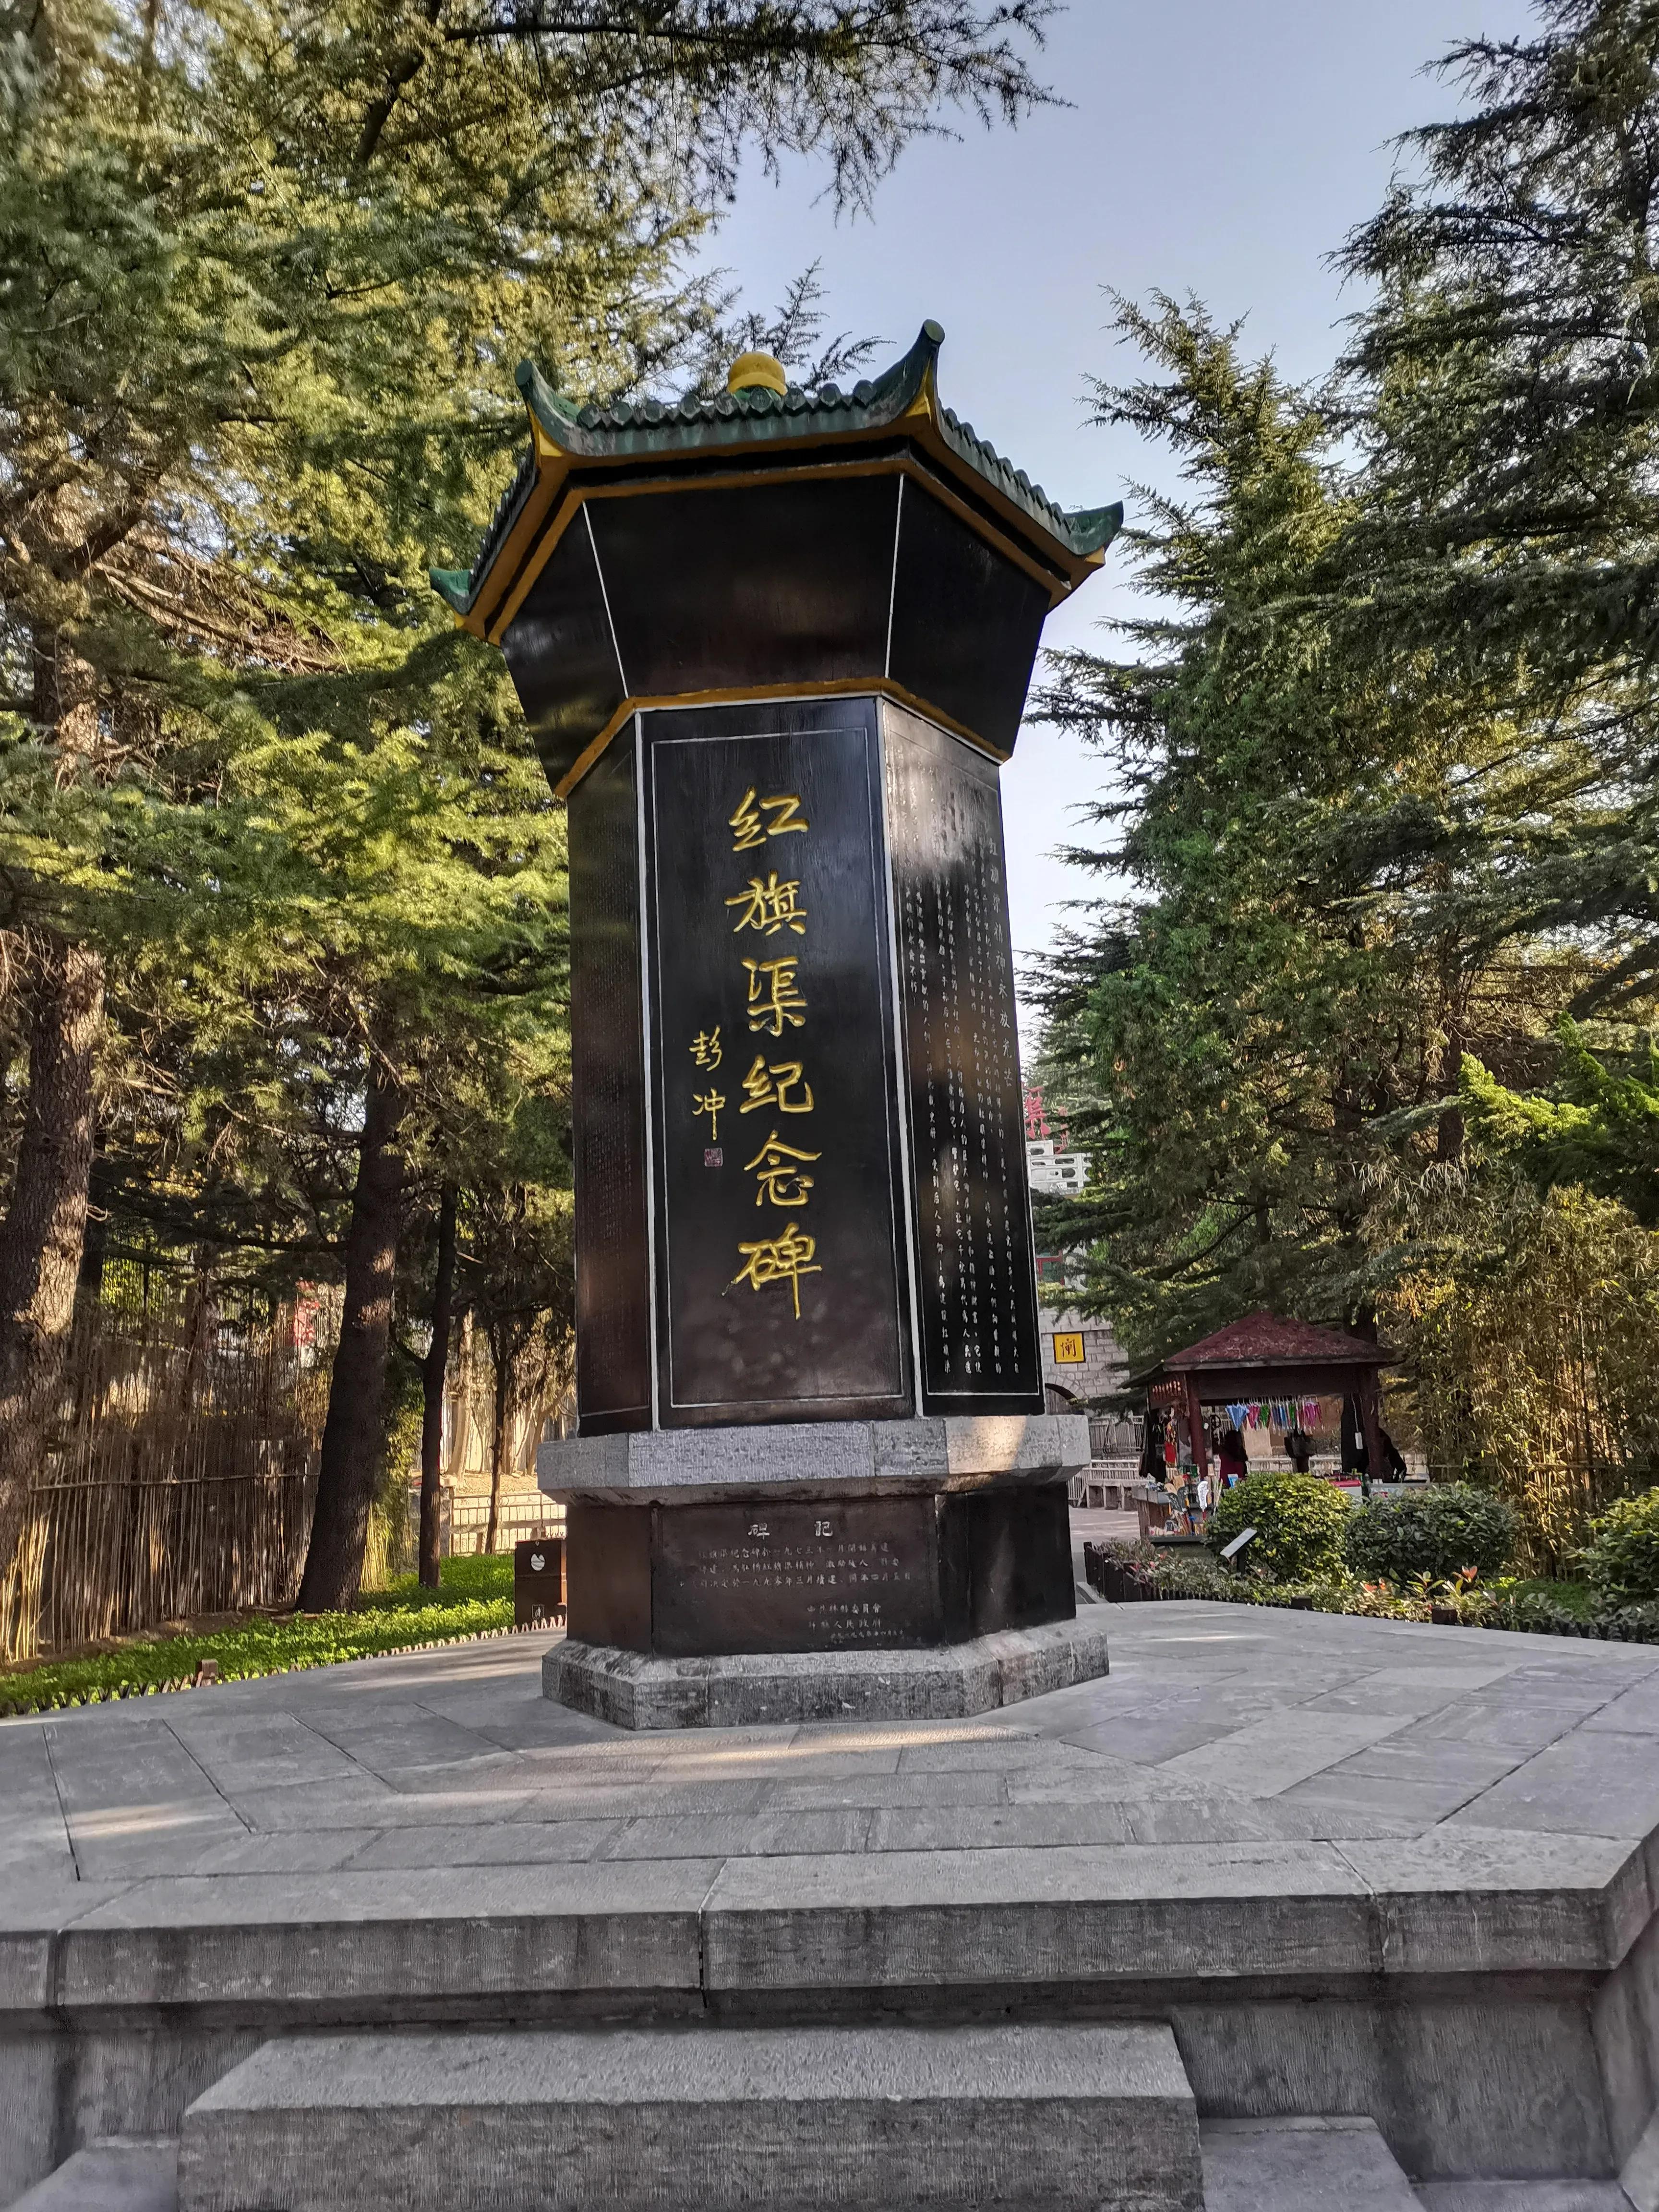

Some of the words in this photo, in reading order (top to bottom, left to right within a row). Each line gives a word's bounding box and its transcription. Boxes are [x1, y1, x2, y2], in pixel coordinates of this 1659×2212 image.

[689, 1025, 727, 1140] 彭冲
[723, 785, 822, 1320] 红旗渠纪念碑
